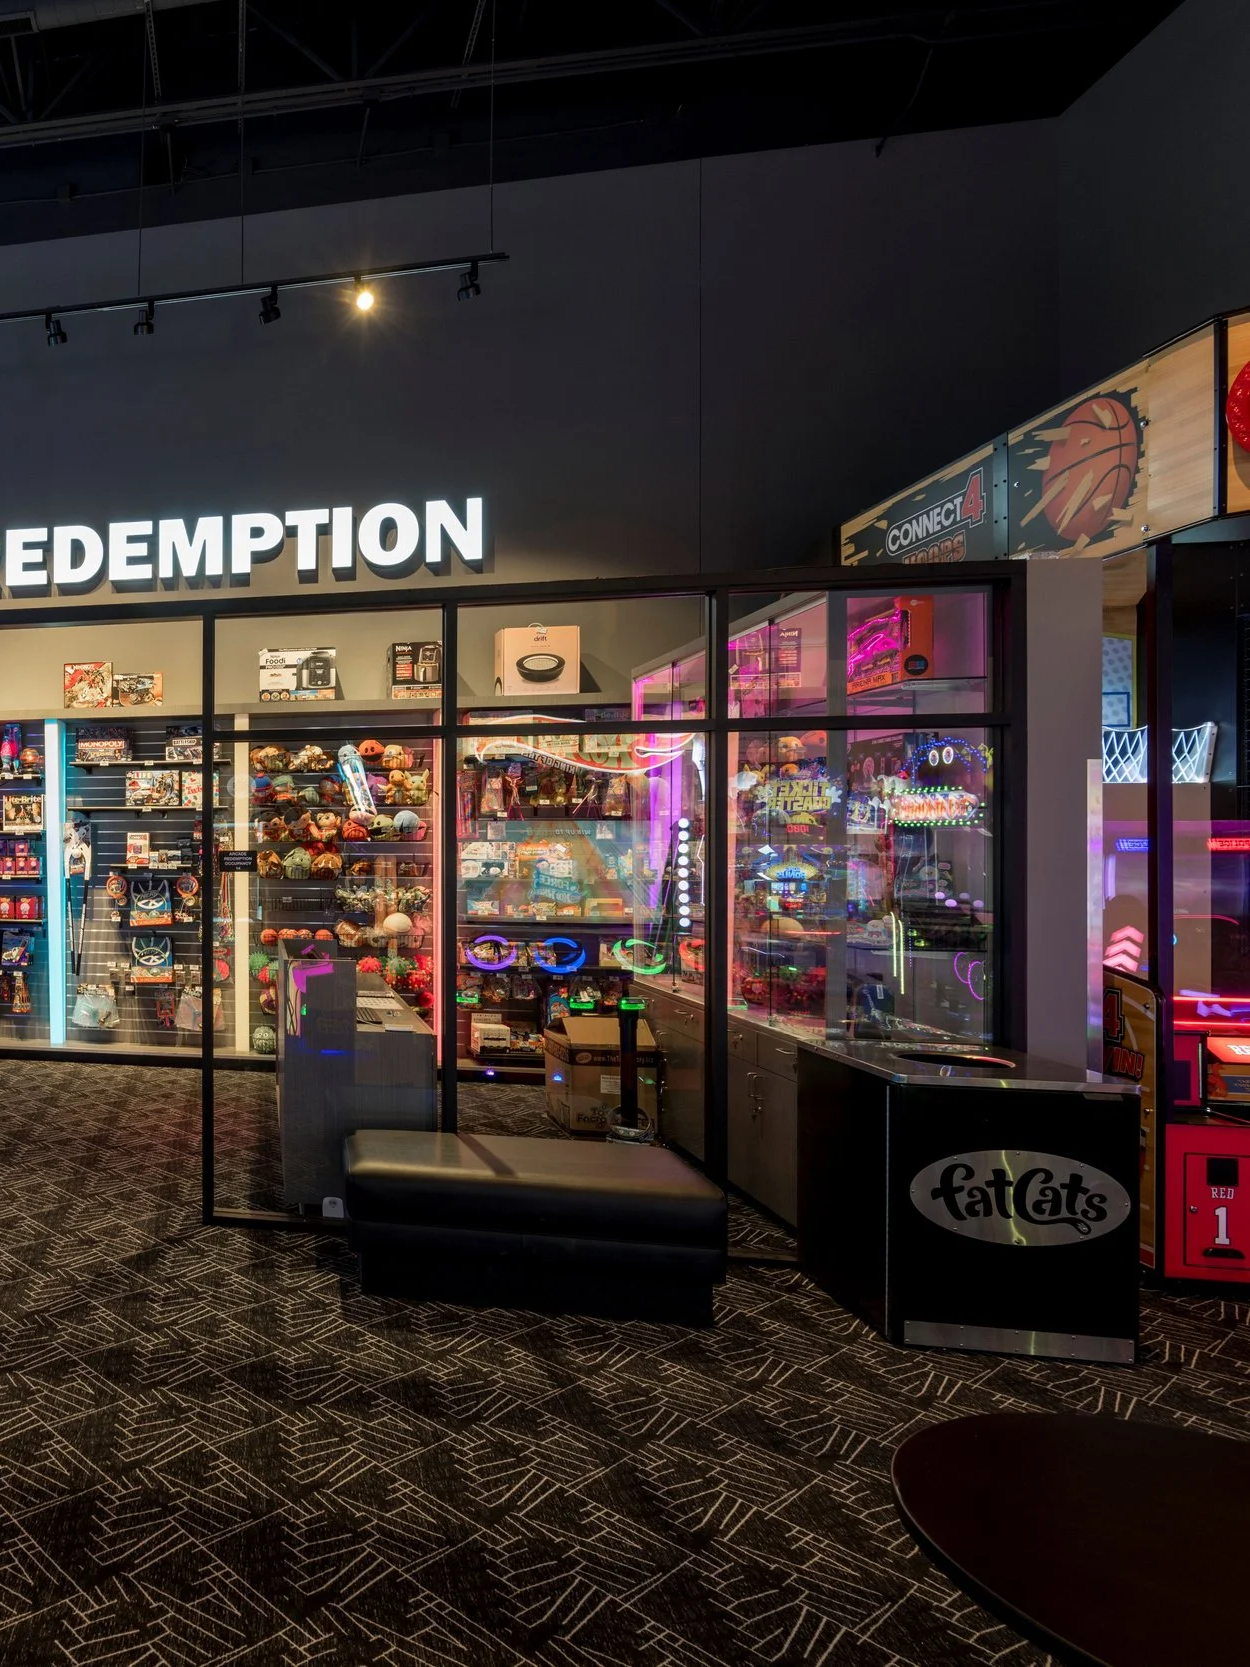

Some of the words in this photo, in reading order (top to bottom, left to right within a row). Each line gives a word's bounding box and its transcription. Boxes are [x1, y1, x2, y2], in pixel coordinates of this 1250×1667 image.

[888, 496, 963, 551] CONNECT
[961, 474, 983, 520] 4
[80, 740, 124, 748] MONOPOLY
[1103, 1046, 1143, 1079] IN!
[1211, 1187, 1234, 1199] RED
[1215, 1206, 1230, 1245] 1
